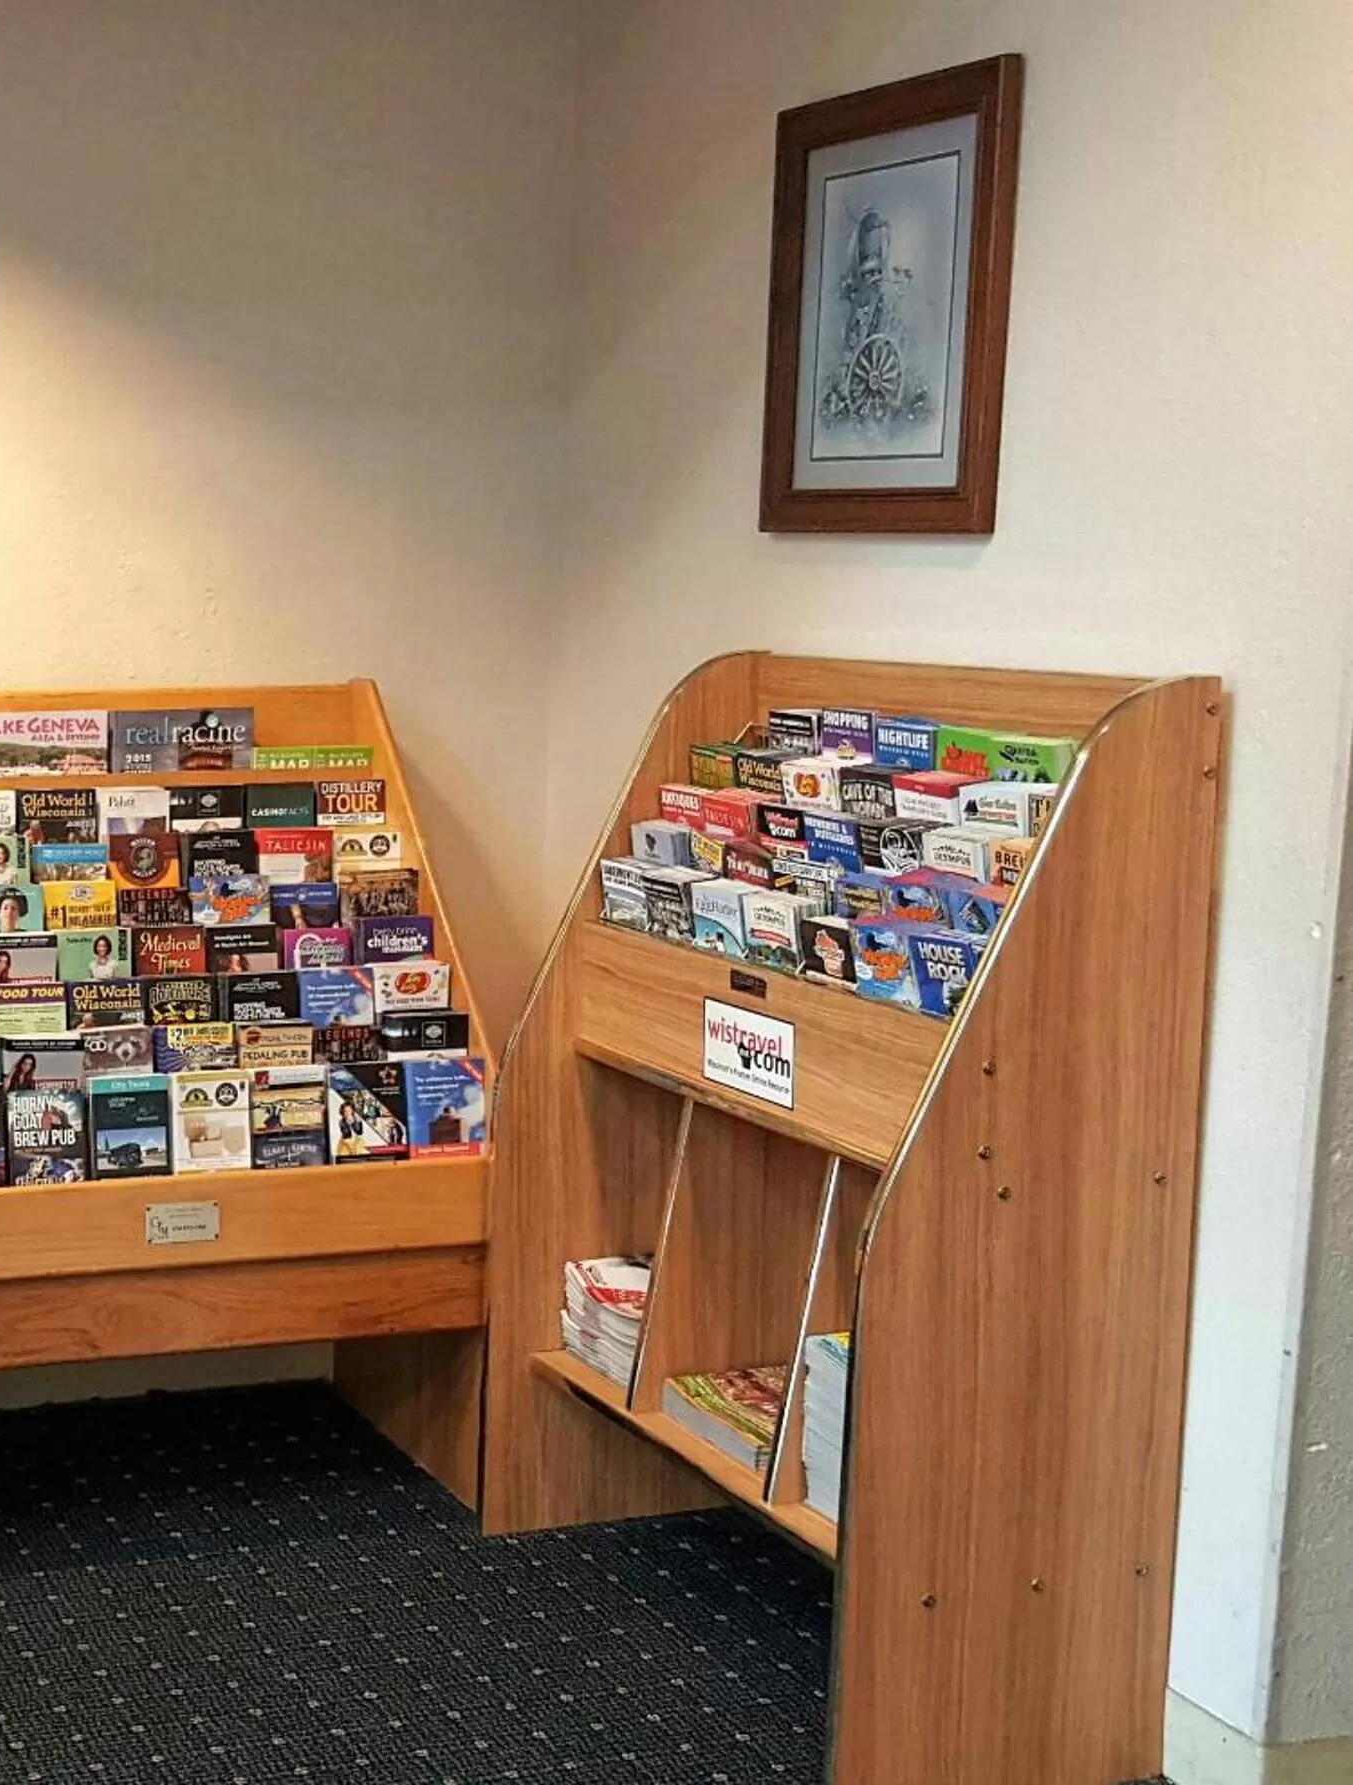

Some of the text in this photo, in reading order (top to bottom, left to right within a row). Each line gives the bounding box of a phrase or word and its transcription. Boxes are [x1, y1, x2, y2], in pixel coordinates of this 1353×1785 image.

[27, 716, 100, 734] GENEVA
[823, 710, 869, 730] SHOPPING
[172, 714, 246, 744] racine
[877, 727, 928, 750] NIGHTLIFE
[321, 781, 384, 795] DISTILLERY
[22, 793, 86, 806] Old World
[324, 794, 378, 813] TOUR
[22, 806, 86, 818] Wisconsin
[140, 932, 201, 956] Medieval
[367, 934, 428, 949] children's
[151, 952, 191, 970] Times
[917, 942, 964, 966] HOUSE
[31, 986, 65, 997] TOUR
[73, 983, 141, 1000] Old World
[75, 999, 142, 1011] Wisconsin
[707, 1016, 783, 1058] wistravel
[243, 1048, 308, 1061] PEDALING PUB
[12, 1096, 54, 1112] HORNY
[12, 1112, 44, 1129] GOAT
[13, 1128, 77, 1147] BREW PUB
